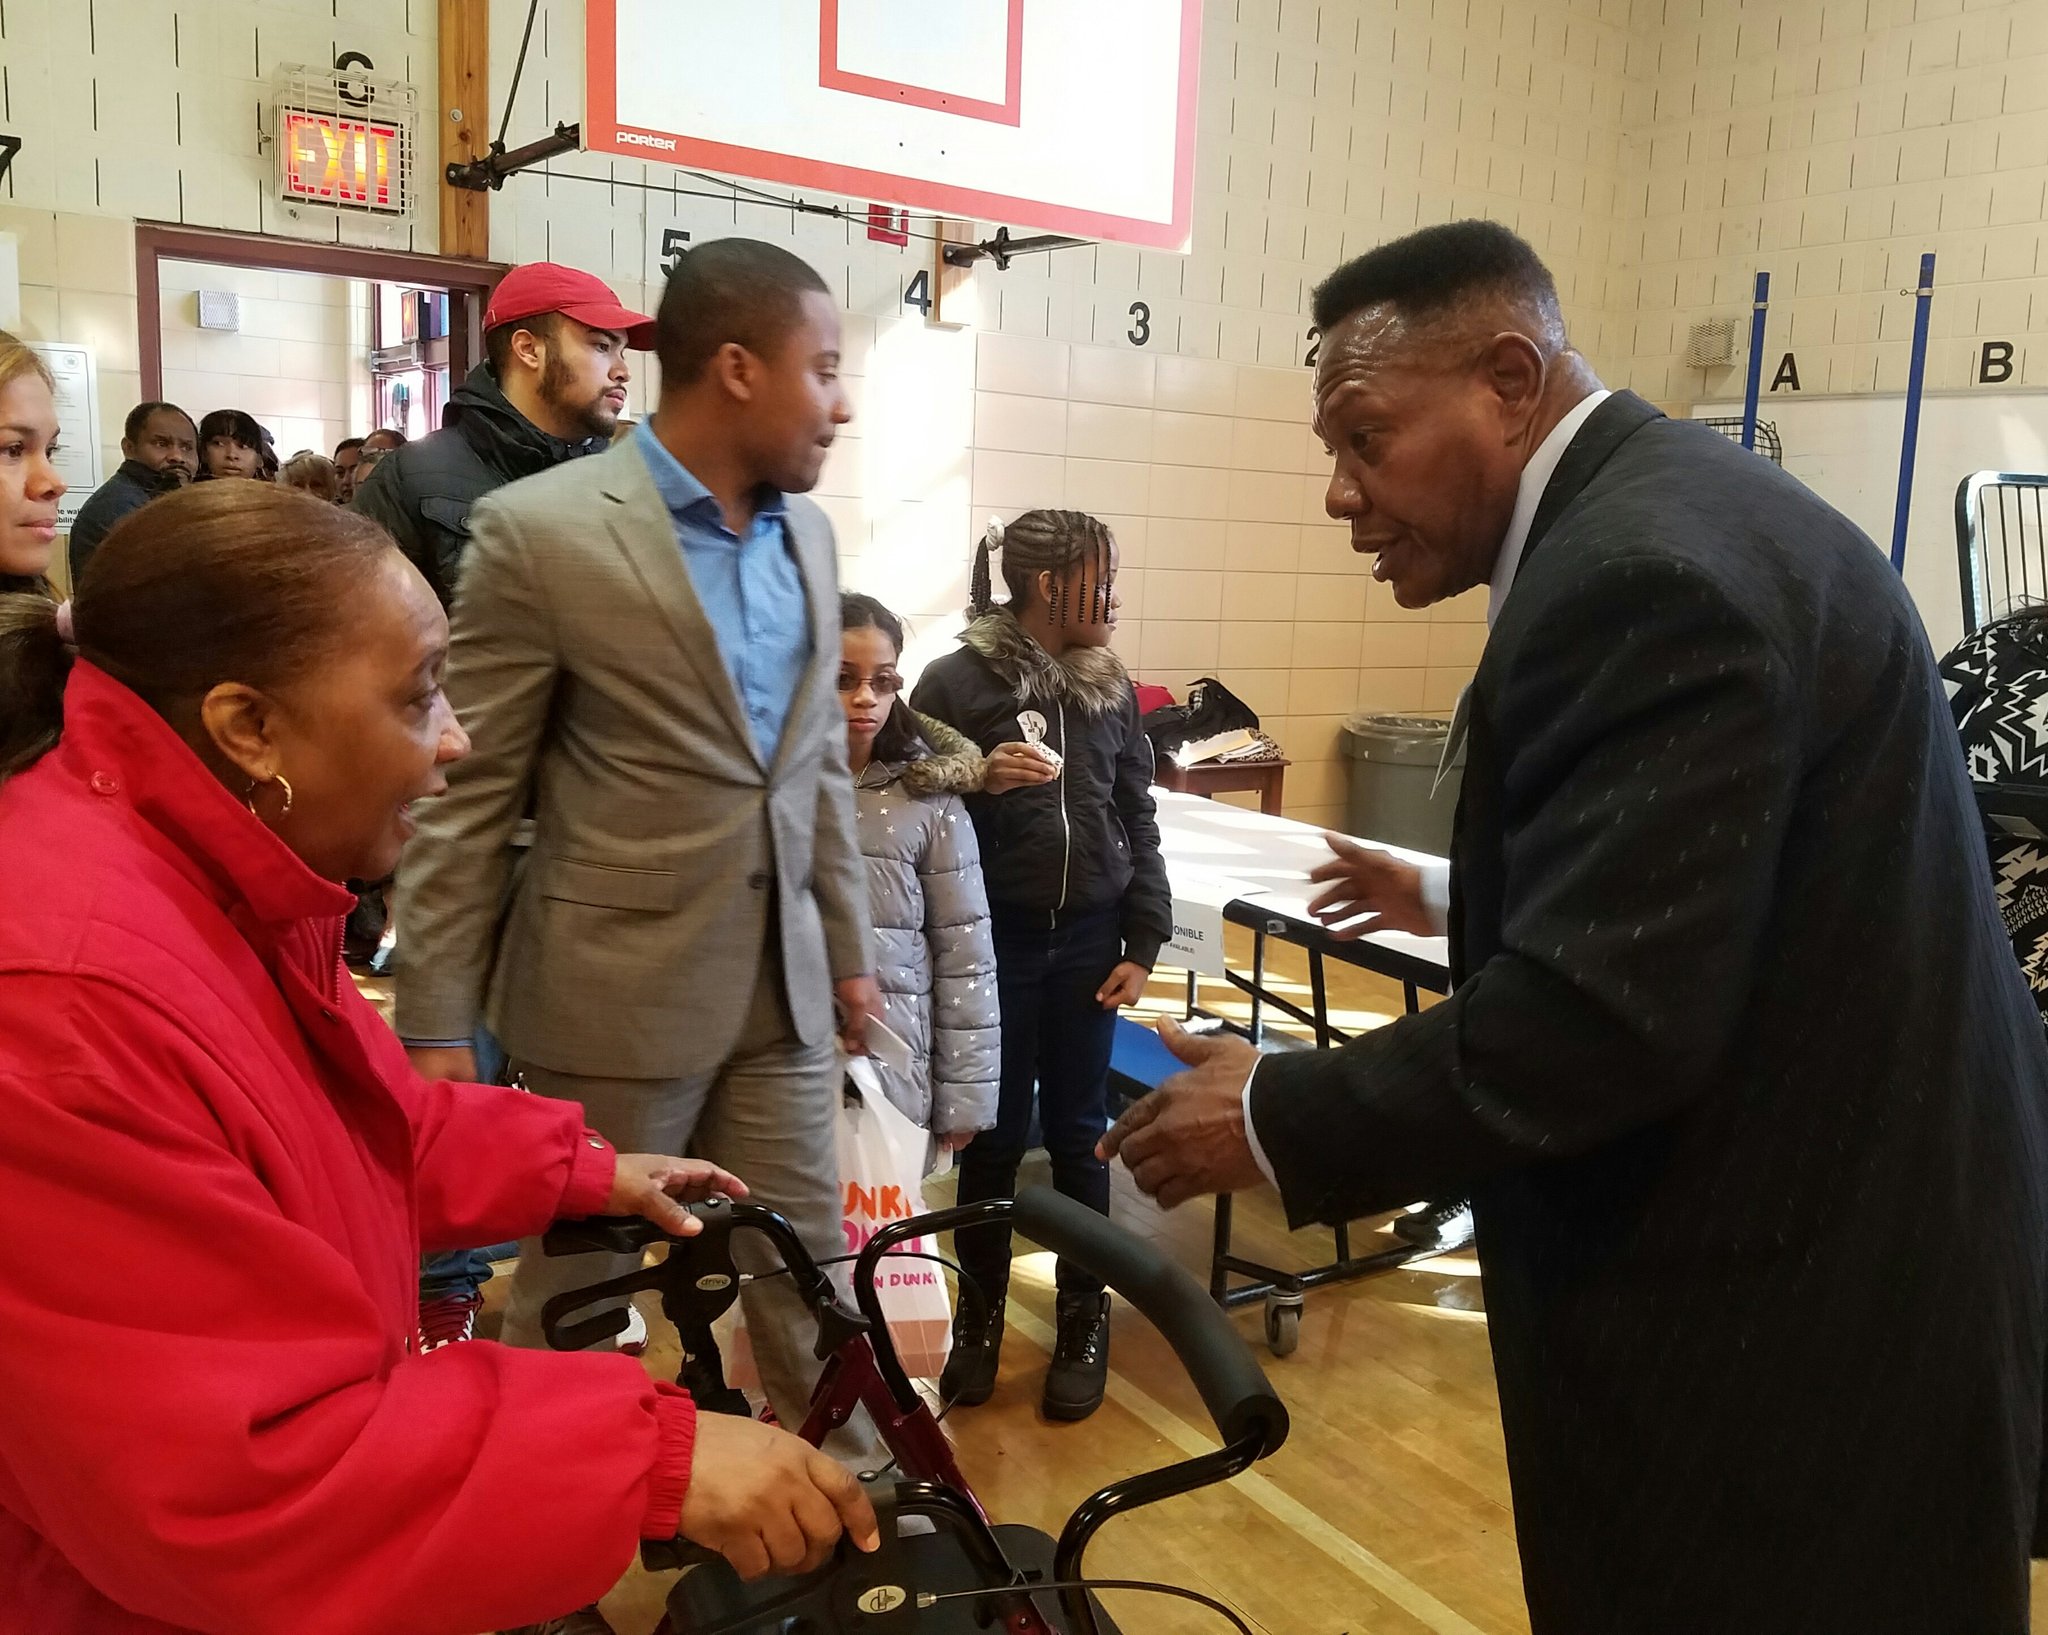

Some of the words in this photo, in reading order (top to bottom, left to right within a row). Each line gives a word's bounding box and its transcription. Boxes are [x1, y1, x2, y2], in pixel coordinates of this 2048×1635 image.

[287, 114, 395, 204] EXIT
[660, 228, 691, 280] 5
[904, 269, 932, 318] 4
[1127, 301, 1151, 347] 3
[1304, 325, 1323, 367] 2
[1769, 352, 1801, 392] A
[1978, 341, 2014, 384] B
[1173, 924, 1205, 942] ONIBLE
